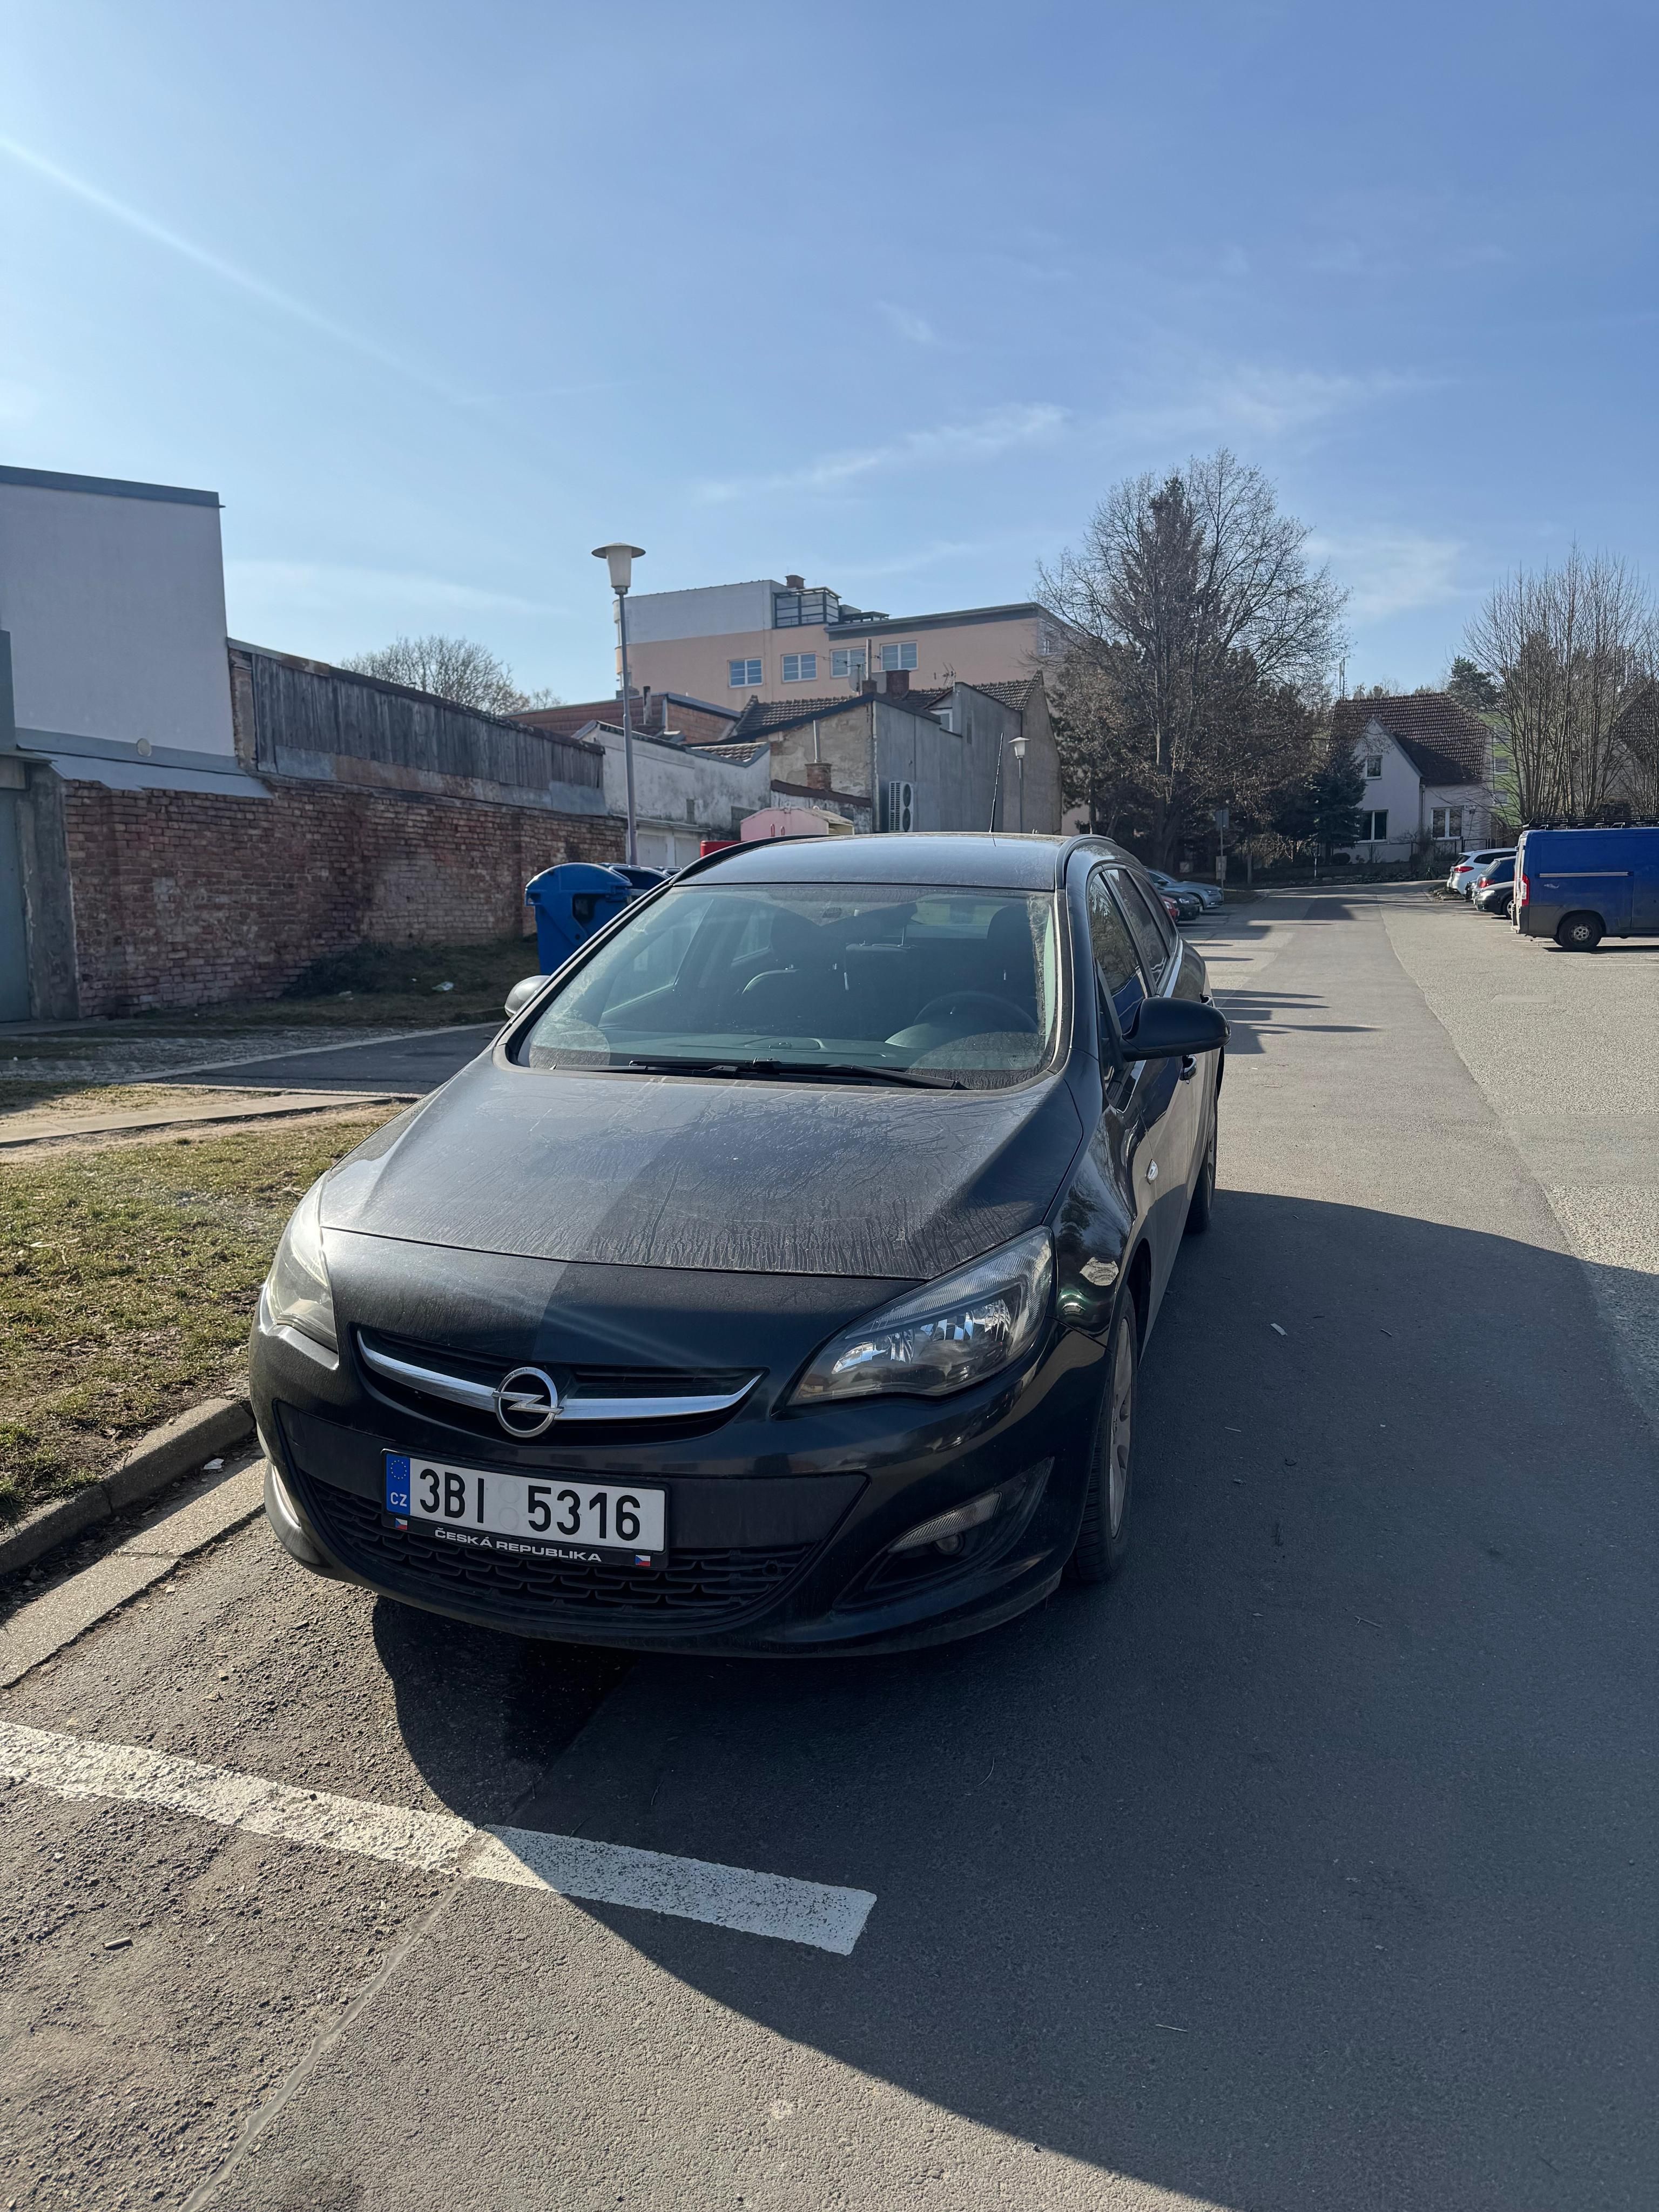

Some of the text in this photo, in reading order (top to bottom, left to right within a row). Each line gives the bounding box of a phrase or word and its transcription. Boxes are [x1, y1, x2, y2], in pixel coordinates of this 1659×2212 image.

[390, 1492, 407, 1507] CZ
[420, 1468, 640, 1541] 3BI 5316
[435, 1527, 602, 1562] ČESKÁ REPUBLIKA
